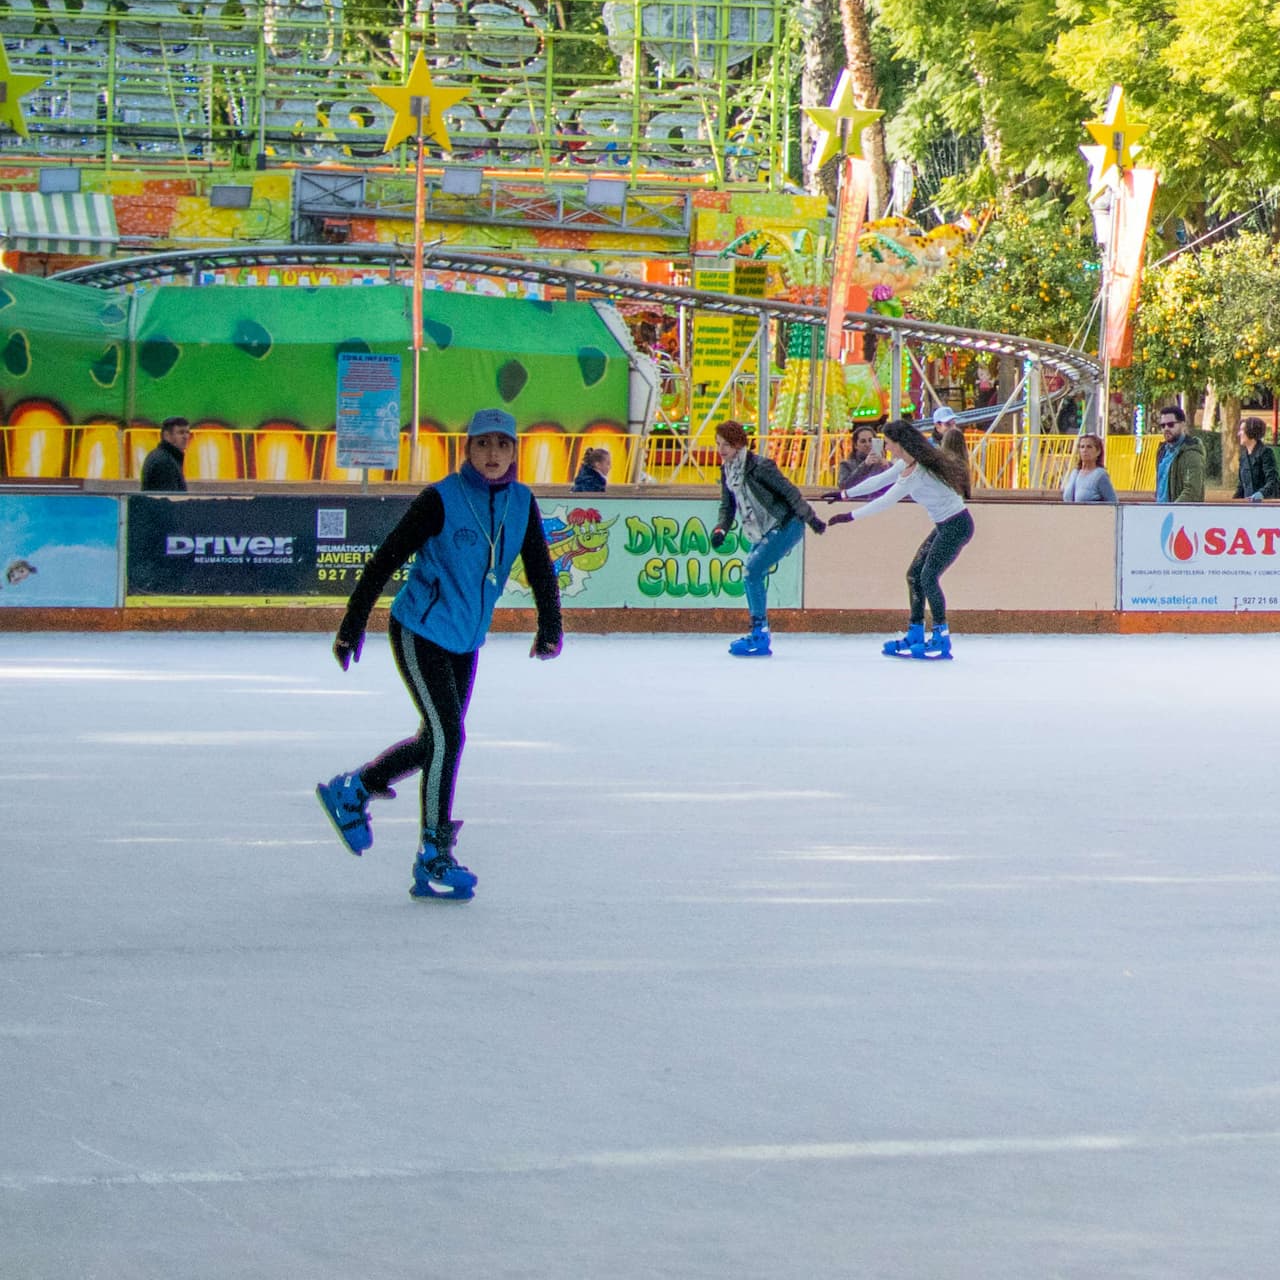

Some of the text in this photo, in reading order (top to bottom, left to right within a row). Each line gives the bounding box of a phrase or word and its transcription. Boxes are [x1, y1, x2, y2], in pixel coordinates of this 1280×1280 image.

[317, 552, 361, 563] JAVIER
[318, 569, 347, 580] 927
[1131, 594, 1218, 605] www.satelca.net
